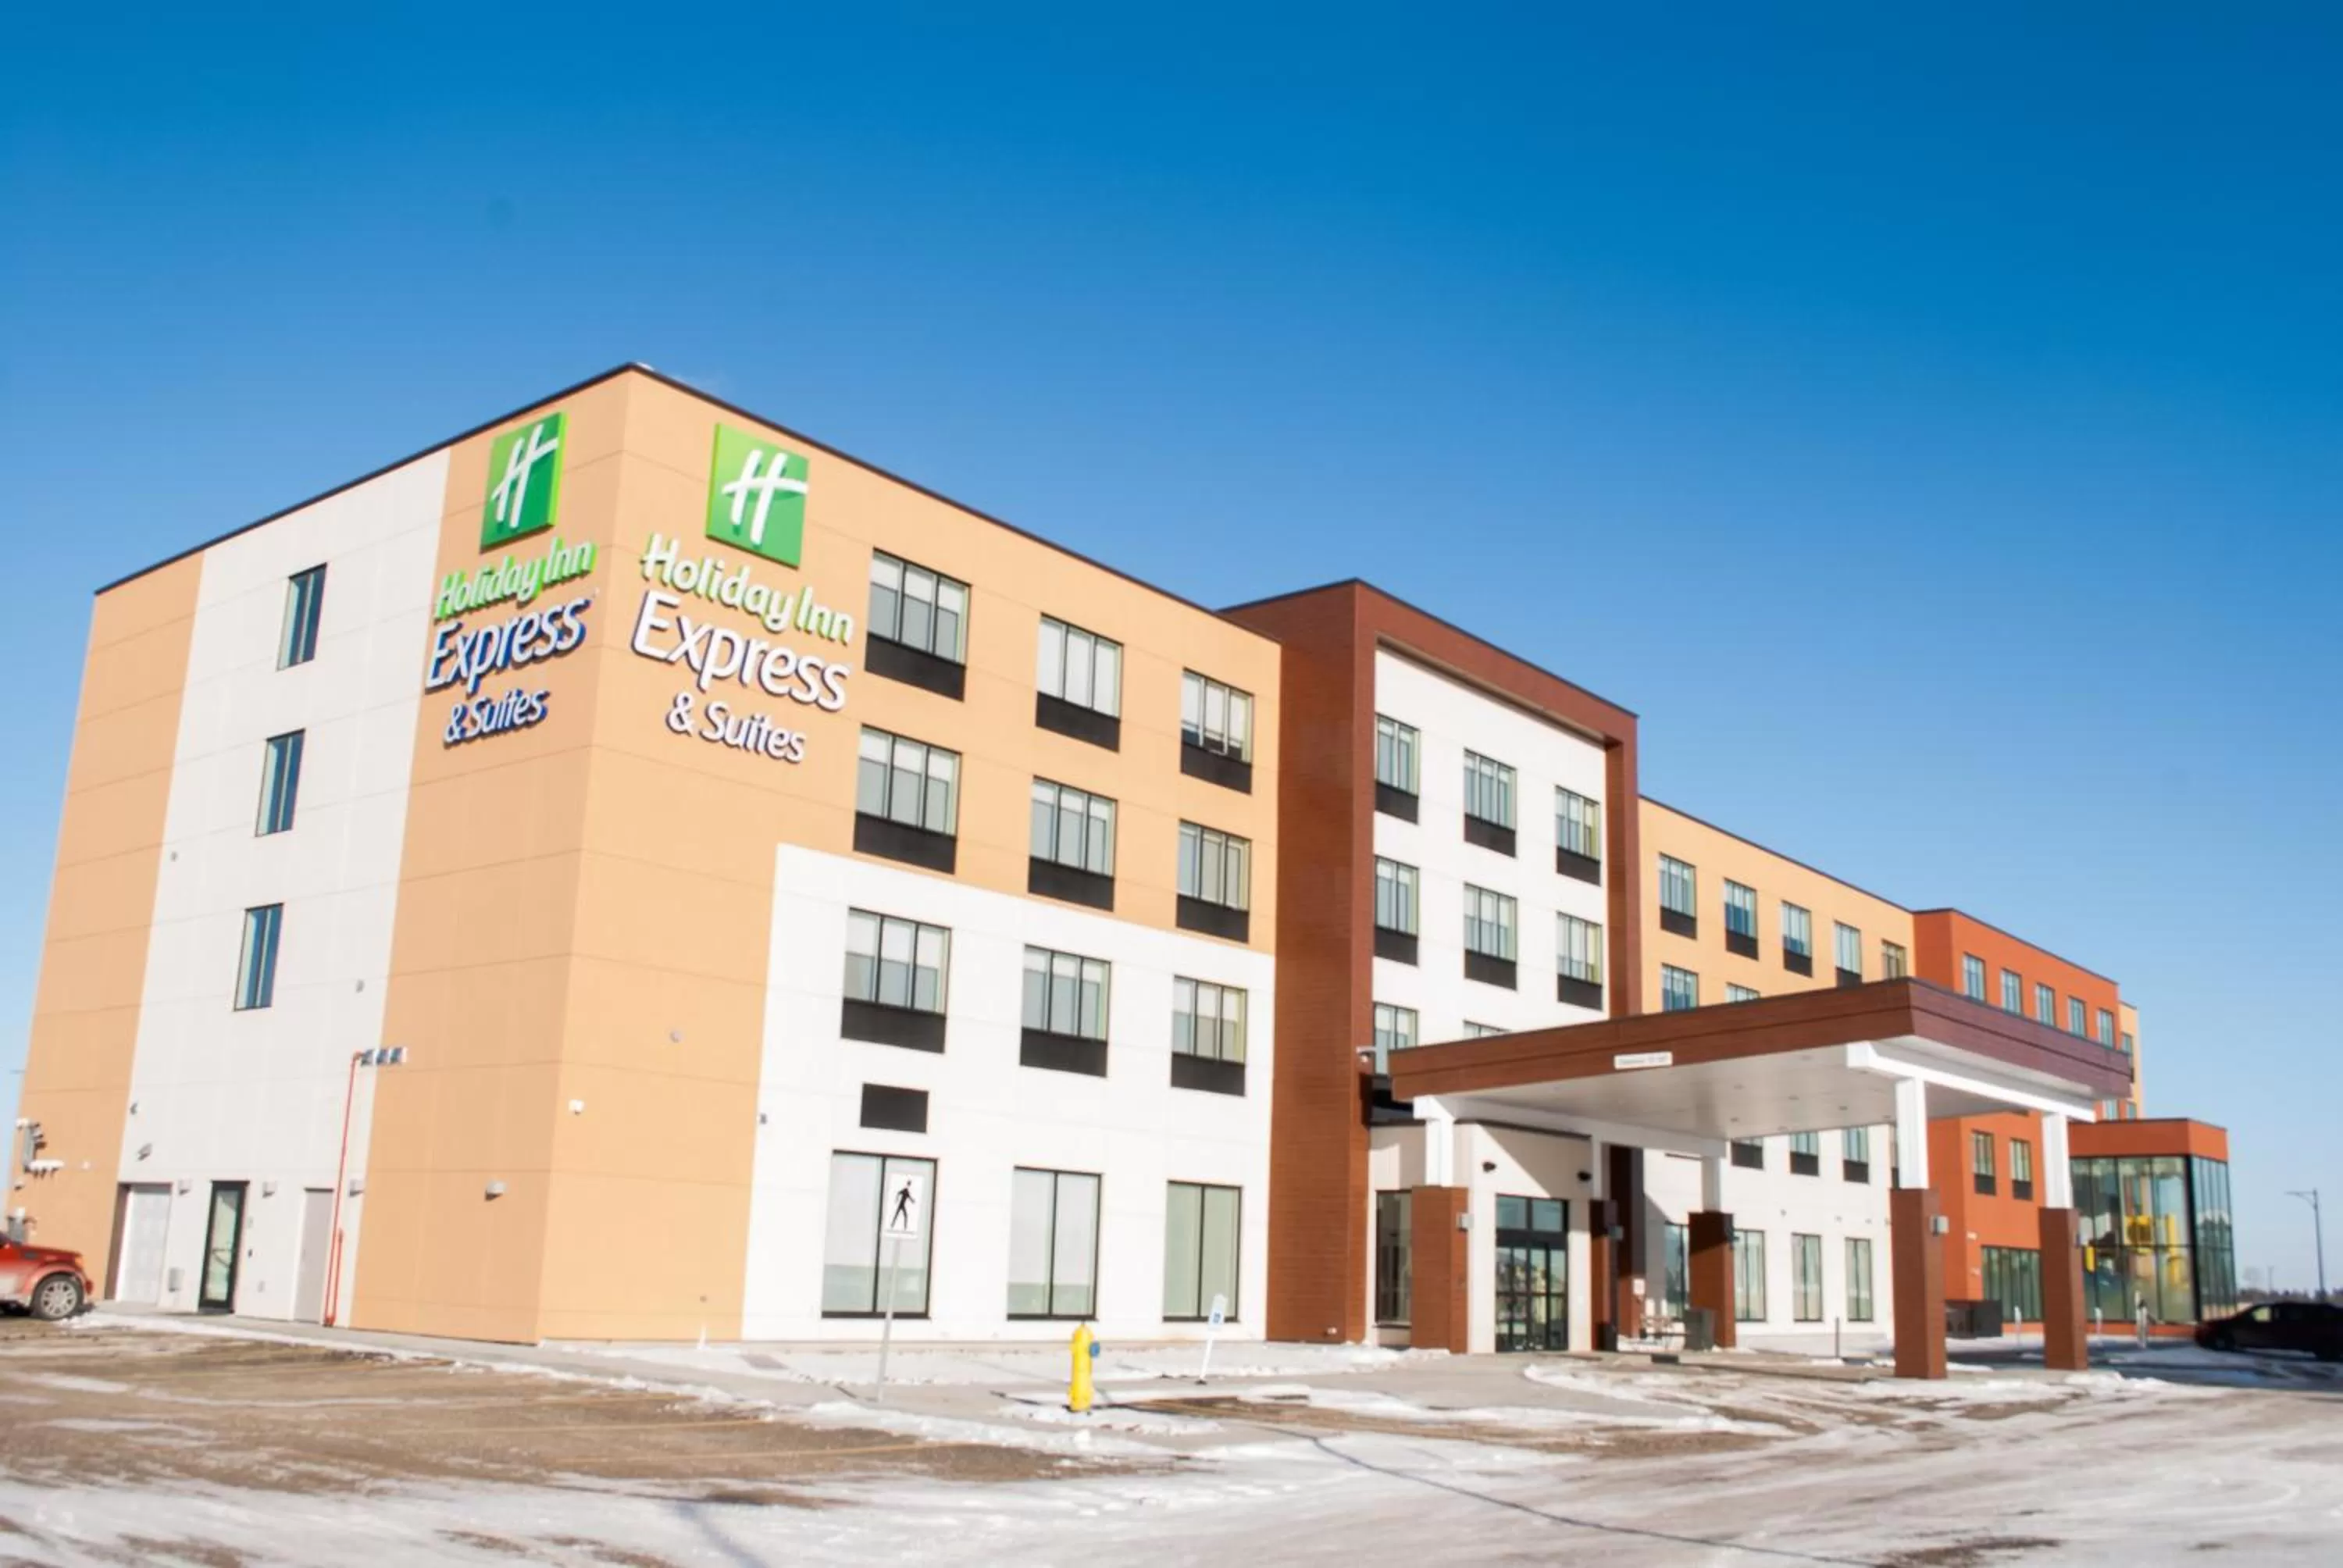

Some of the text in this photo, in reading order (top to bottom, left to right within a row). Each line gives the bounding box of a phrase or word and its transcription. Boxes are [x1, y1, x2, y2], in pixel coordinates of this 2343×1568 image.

[434, 536, 598, 622] Holiday Inn
[640, 533, 854, 645] Holiday Inn
[425, 598, 591, 699] Express
[631, 590, 851, 712] Express
[444, 690, 549, 746] & Suites
[665, 691, 806, 763] & Suites
